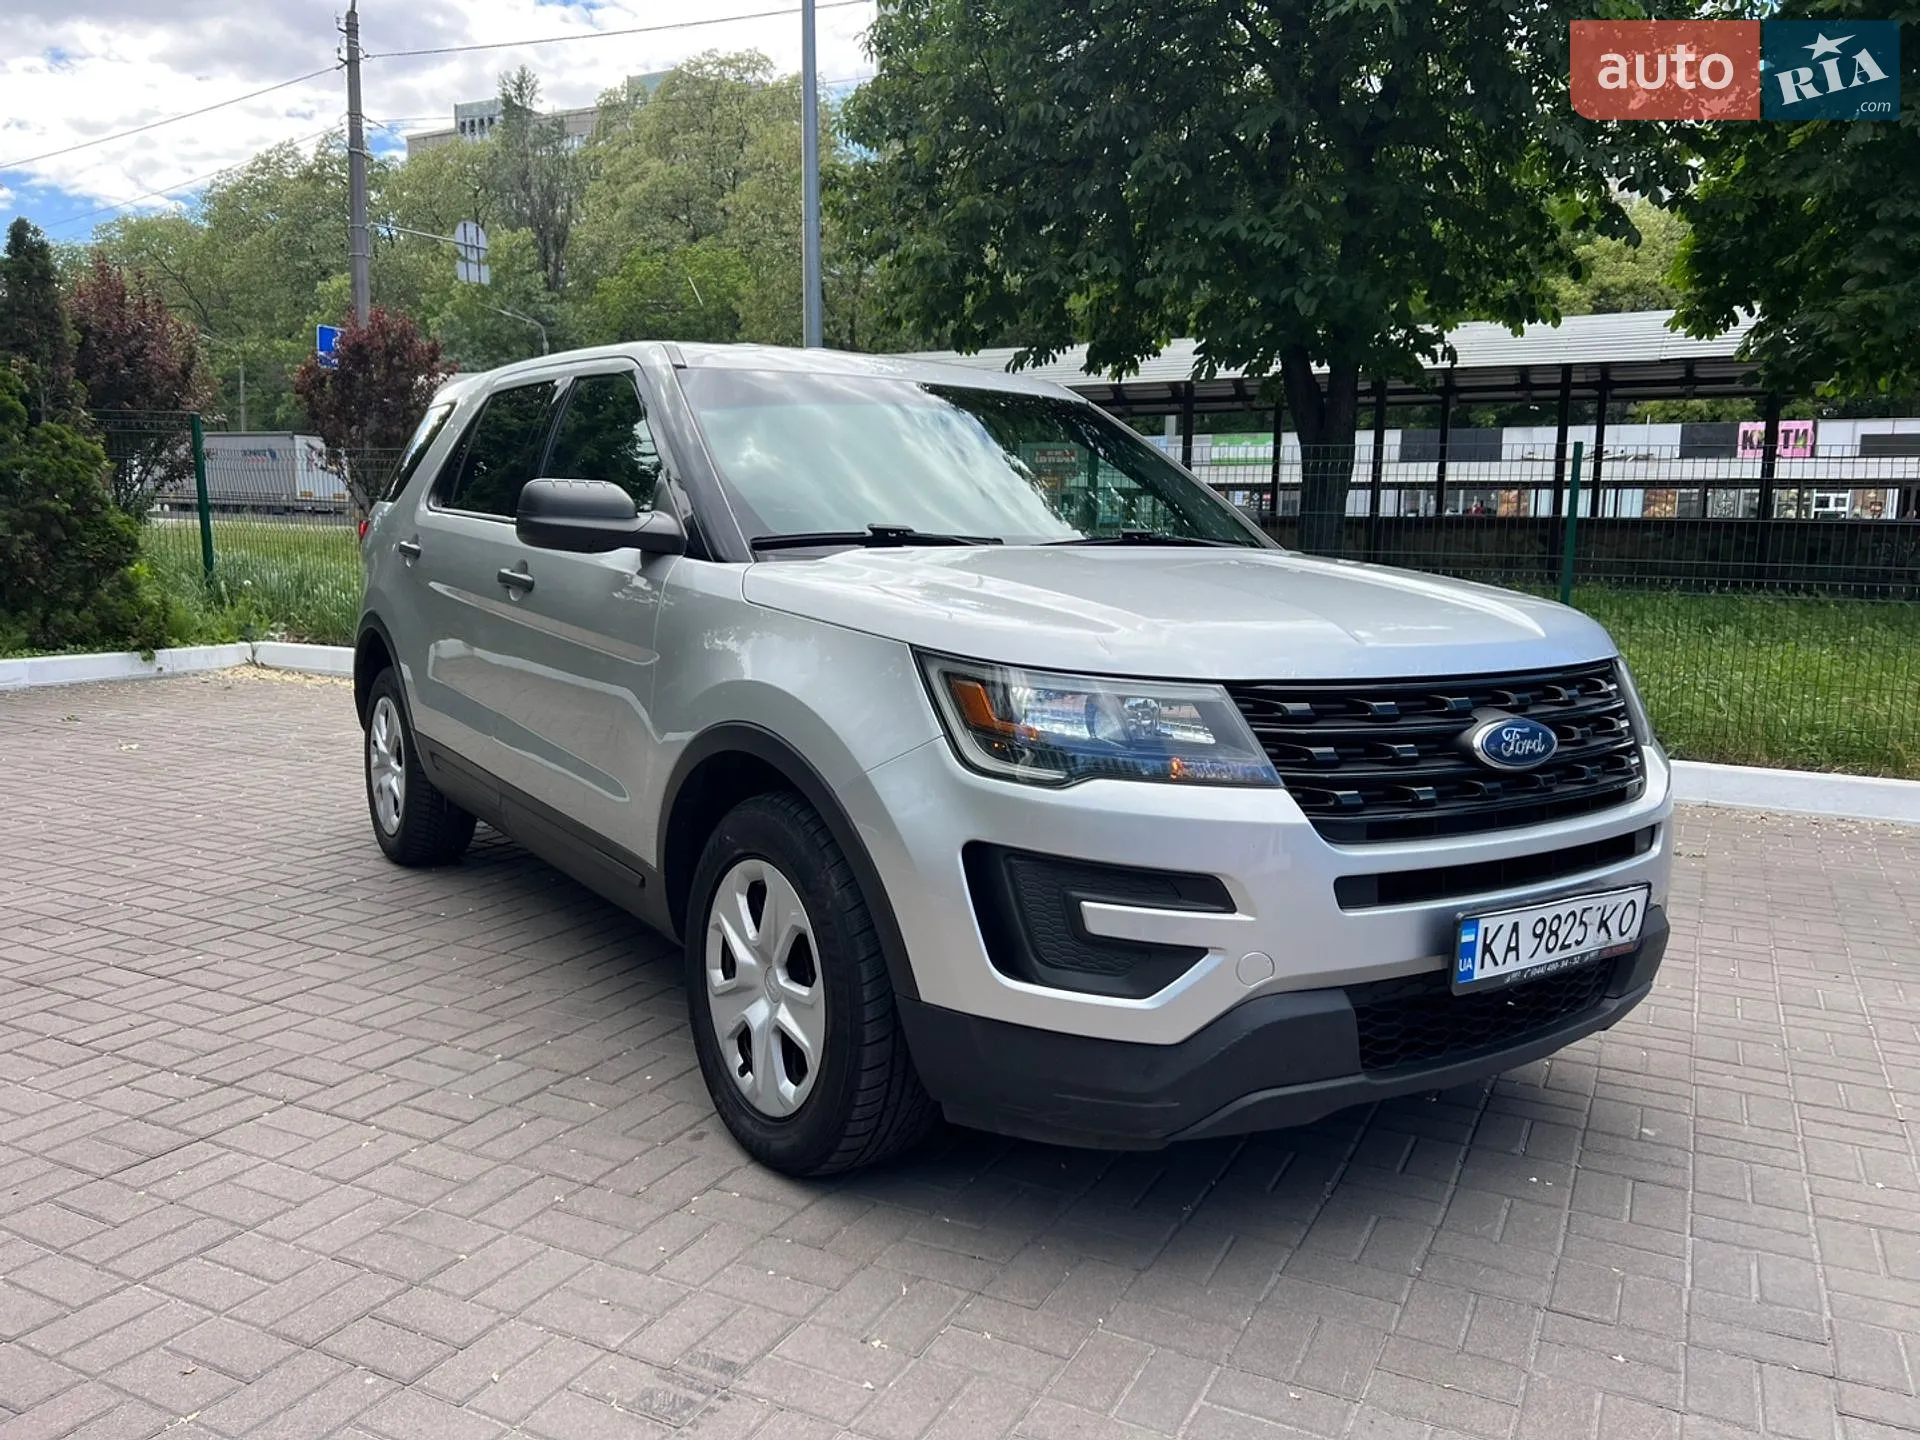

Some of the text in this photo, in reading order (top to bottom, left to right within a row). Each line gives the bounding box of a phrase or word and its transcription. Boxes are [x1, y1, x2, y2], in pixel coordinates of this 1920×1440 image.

[1501, 726, 1545, 757] Ford
[1480, 899, 1637, 970] KA 9825 KO
[1458, 958, 1473, 972] UA
